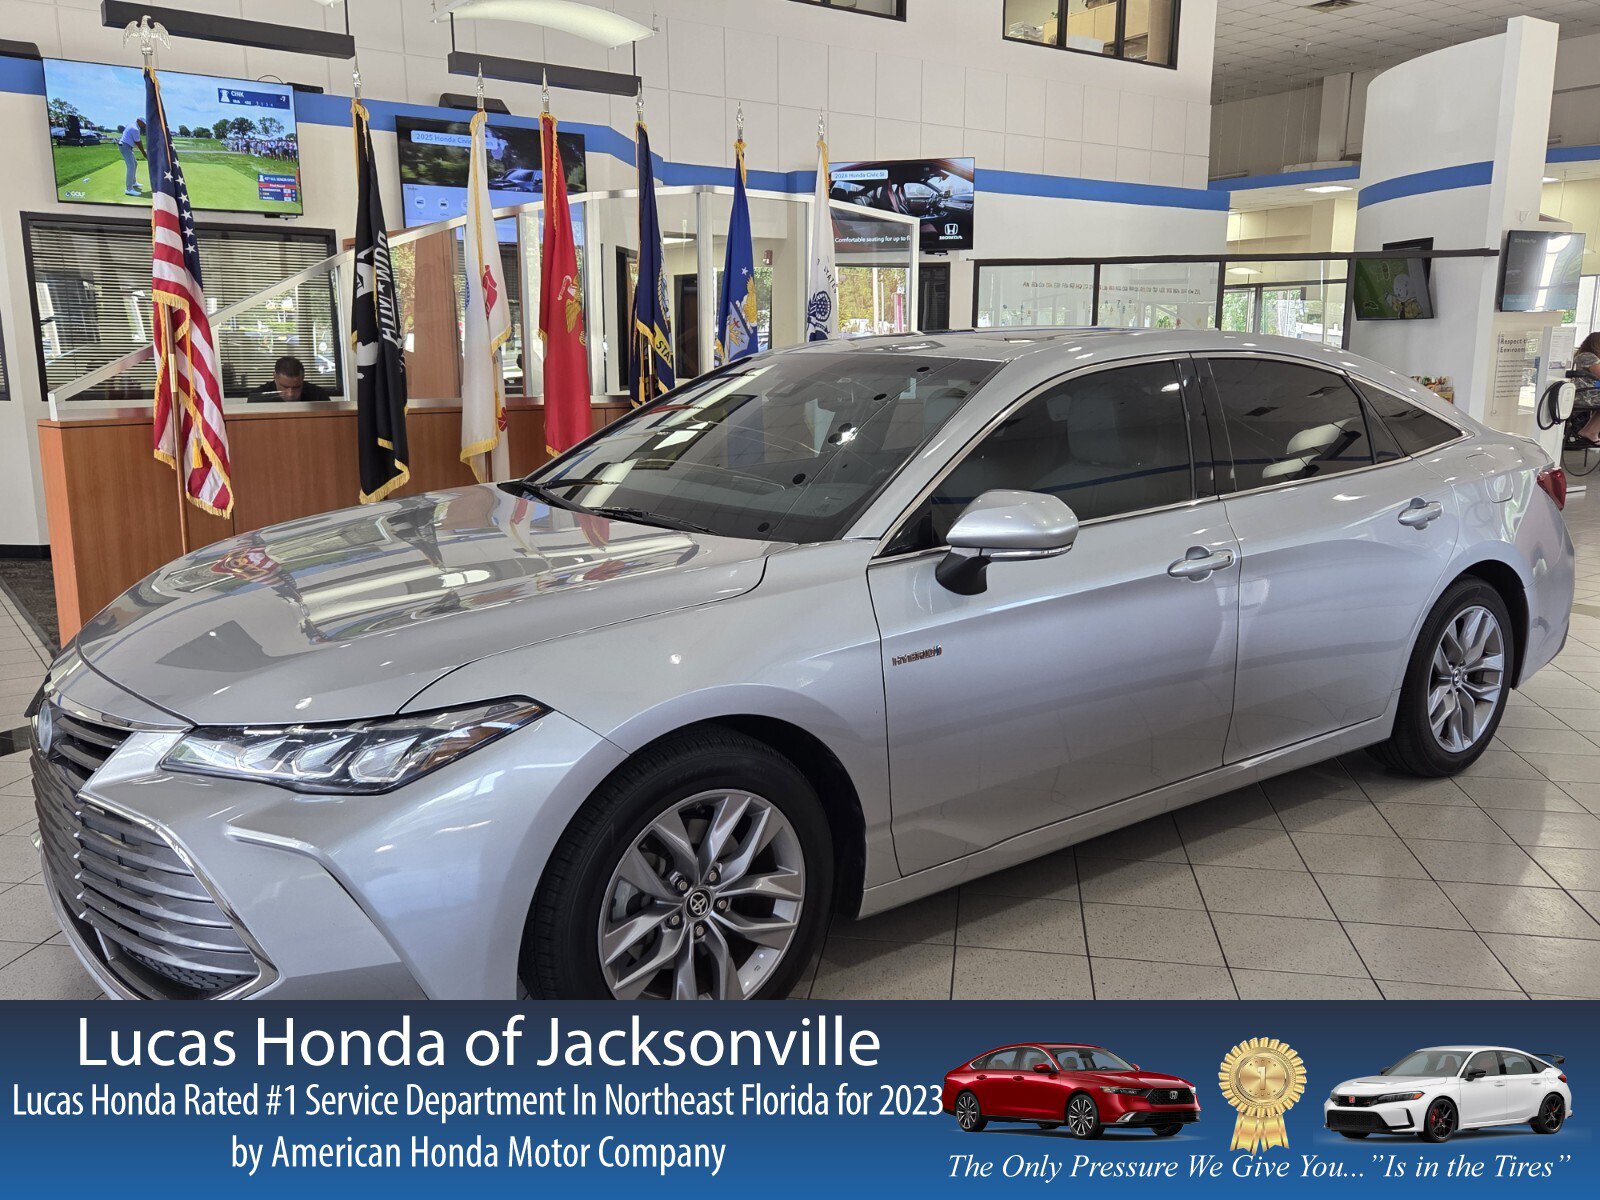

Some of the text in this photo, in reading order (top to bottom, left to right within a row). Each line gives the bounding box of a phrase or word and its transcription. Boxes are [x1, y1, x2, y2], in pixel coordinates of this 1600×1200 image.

[416, 133, 433, 141] 2025
[434, 134, 456, 143] Honda
[866, 236, 885, 244] seating
[1500, 337, 1523, 346] Respect
[656, 340, 671, 364] STA
[892, 645, 943, 666] HYBRID
